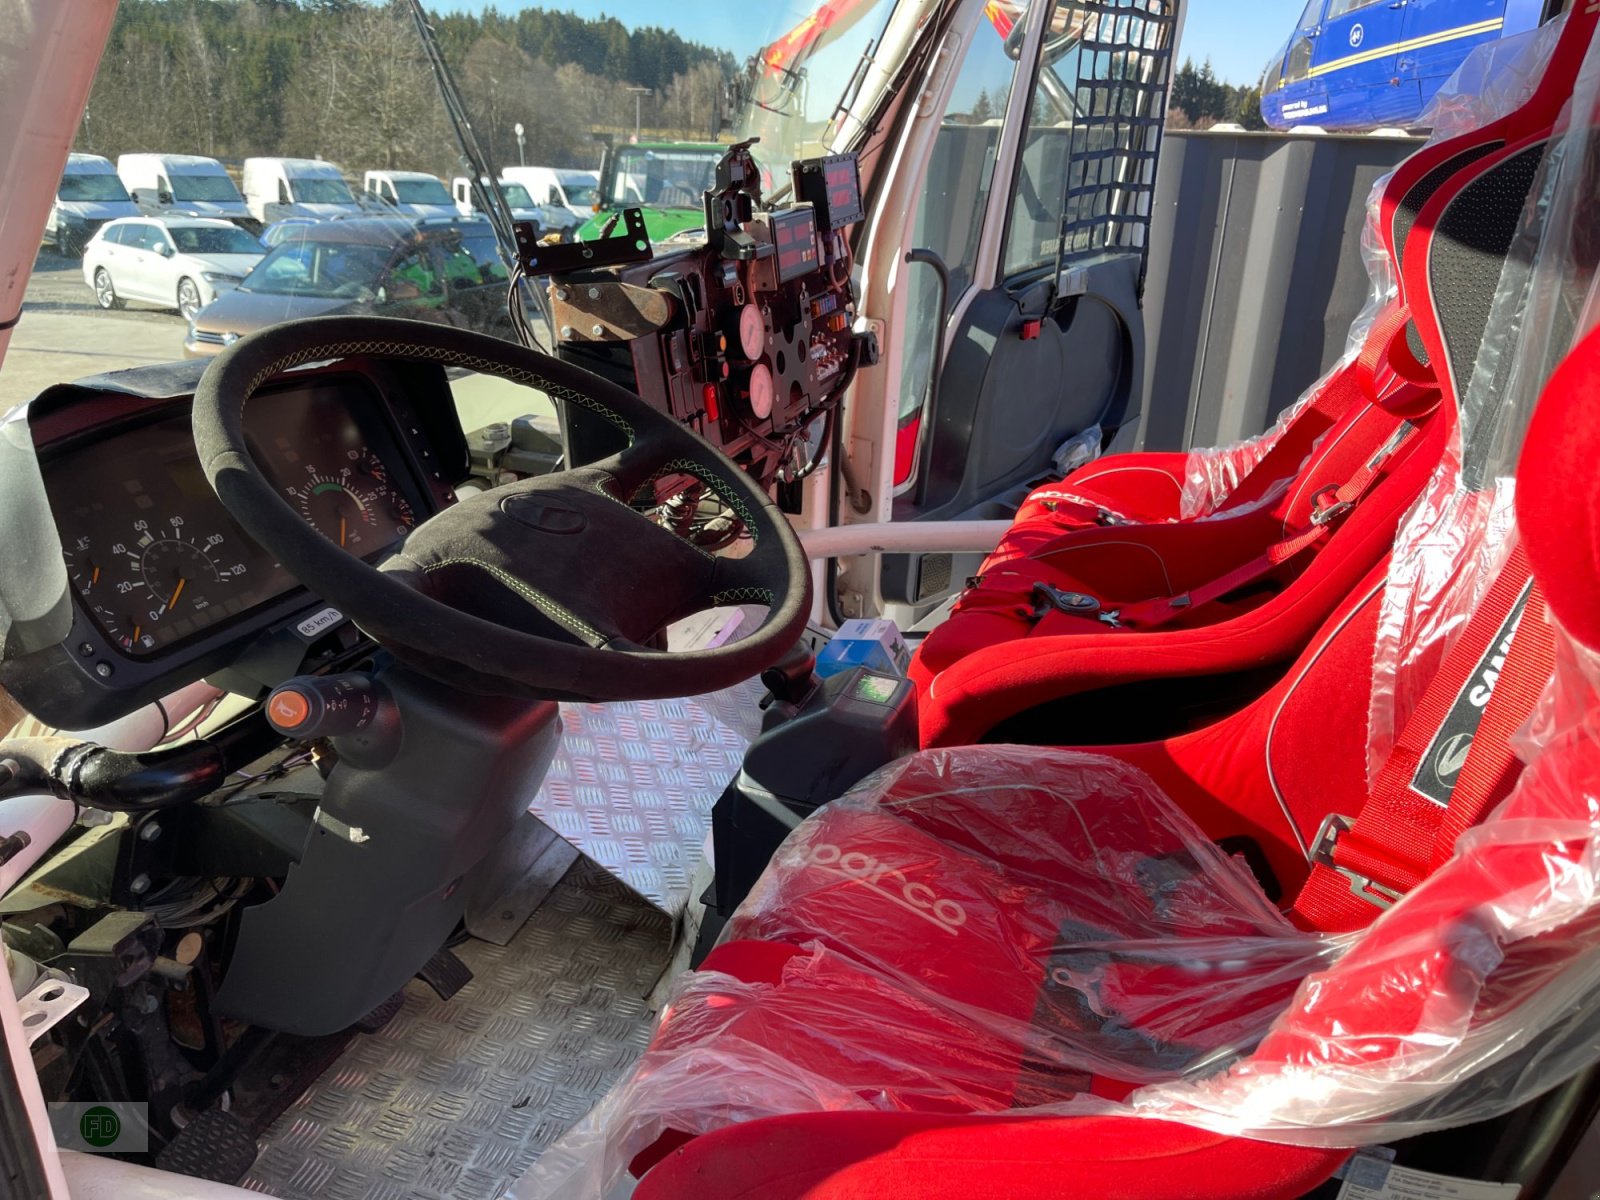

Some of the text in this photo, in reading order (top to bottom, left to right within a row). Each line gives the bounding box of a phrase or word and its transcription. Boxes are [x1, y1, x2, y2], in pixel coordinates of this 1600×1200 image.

[134, 519, 148, 531] 60
[169, 515, 184, 527] 80
[206, 533, 224, 546] 100
[112, 543, 127, 555] 40
[230, 563, 247, 576] 120
[117, 580, 133, 594] 20
[149, 610, 159, 621] 0
[301, 611, 340, 634] 85 km/h
